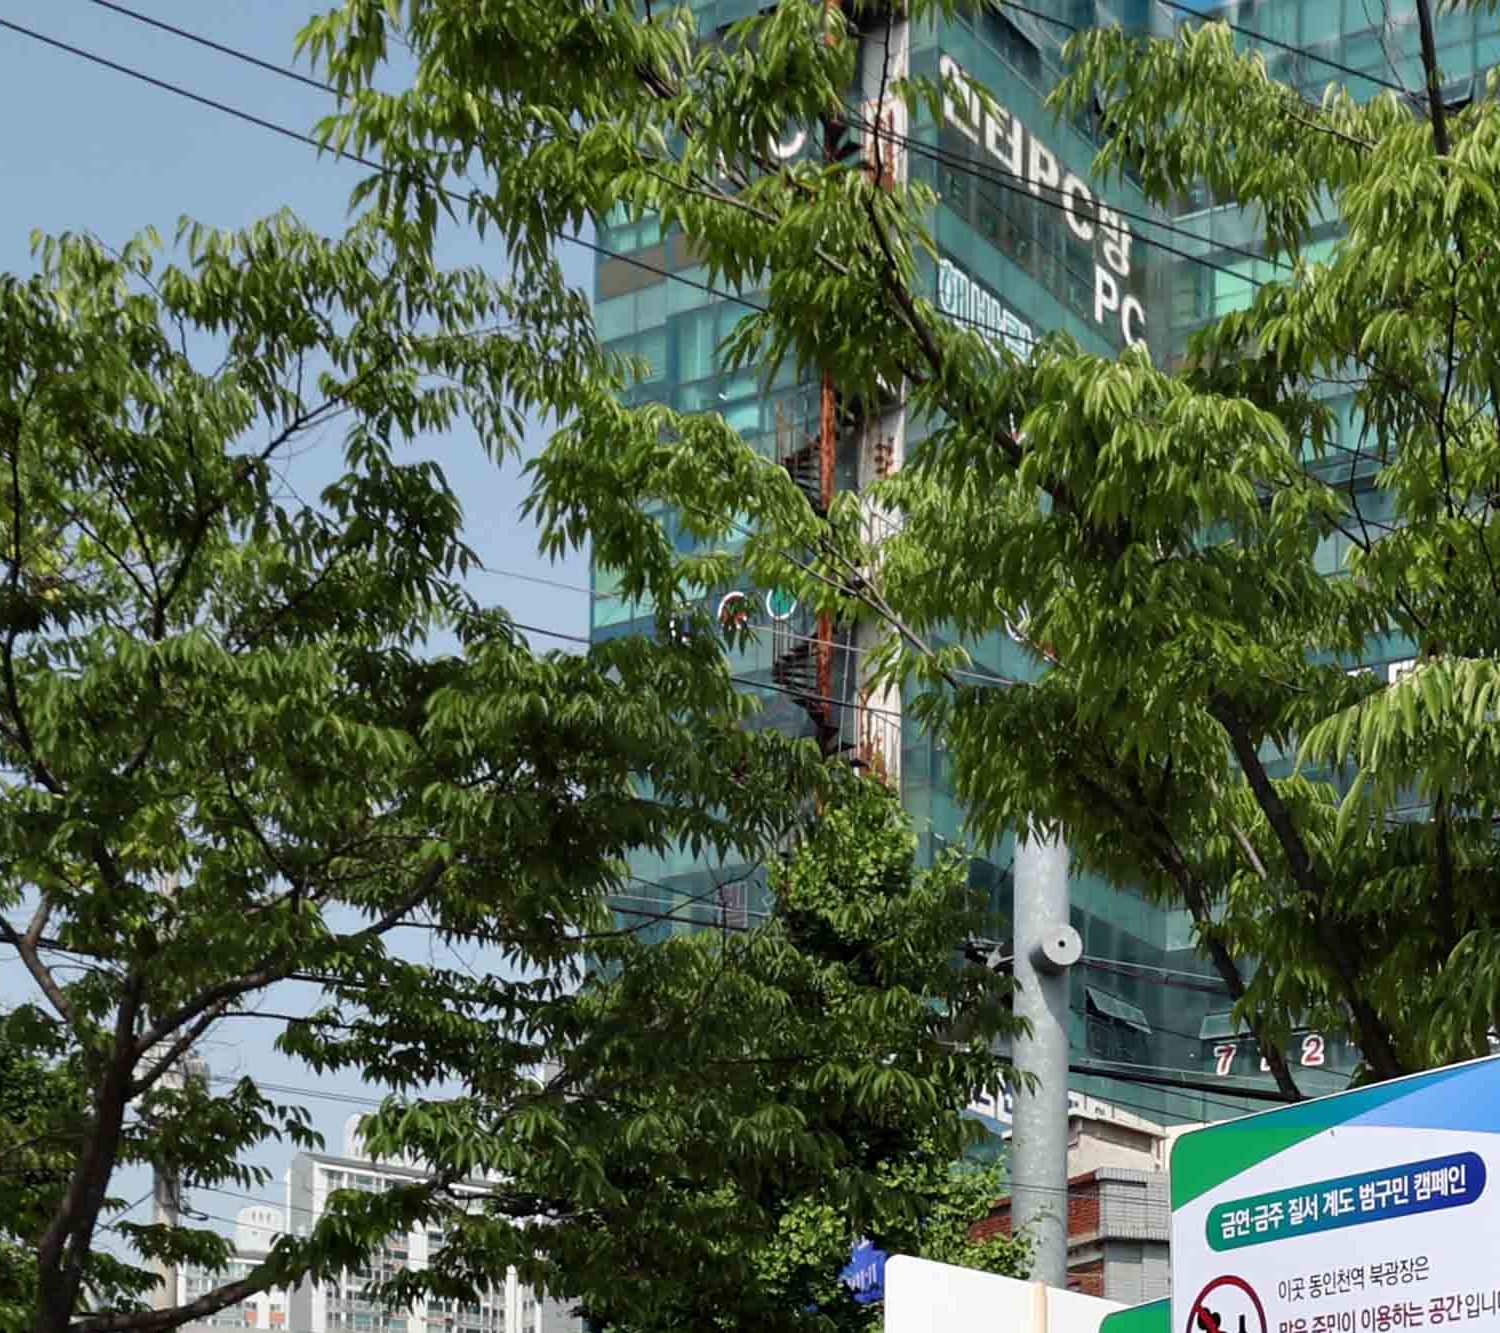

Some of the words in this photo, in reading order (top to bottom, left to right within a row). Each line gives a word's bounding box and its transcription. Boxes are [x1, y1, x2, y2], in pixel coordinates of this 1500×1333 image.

[1221, 1202, 1284, 1238] 금연·금주
[1287, 1194, 1319, 1226] 질서
[1322, 1188, 1356, 1219] 계도
[1358, 1178, 1409, 1212] 범구민
[1413, 1164, 1467, 1200] 캠페인
[1279, 1277, 1306, 1303] 이곳
[1309, 1266, 1367, 1298] 동인천역
[1369, 1256, 1429, 1288] 북광장은
[1361, 1302, 1424, 1333] 이용하는
